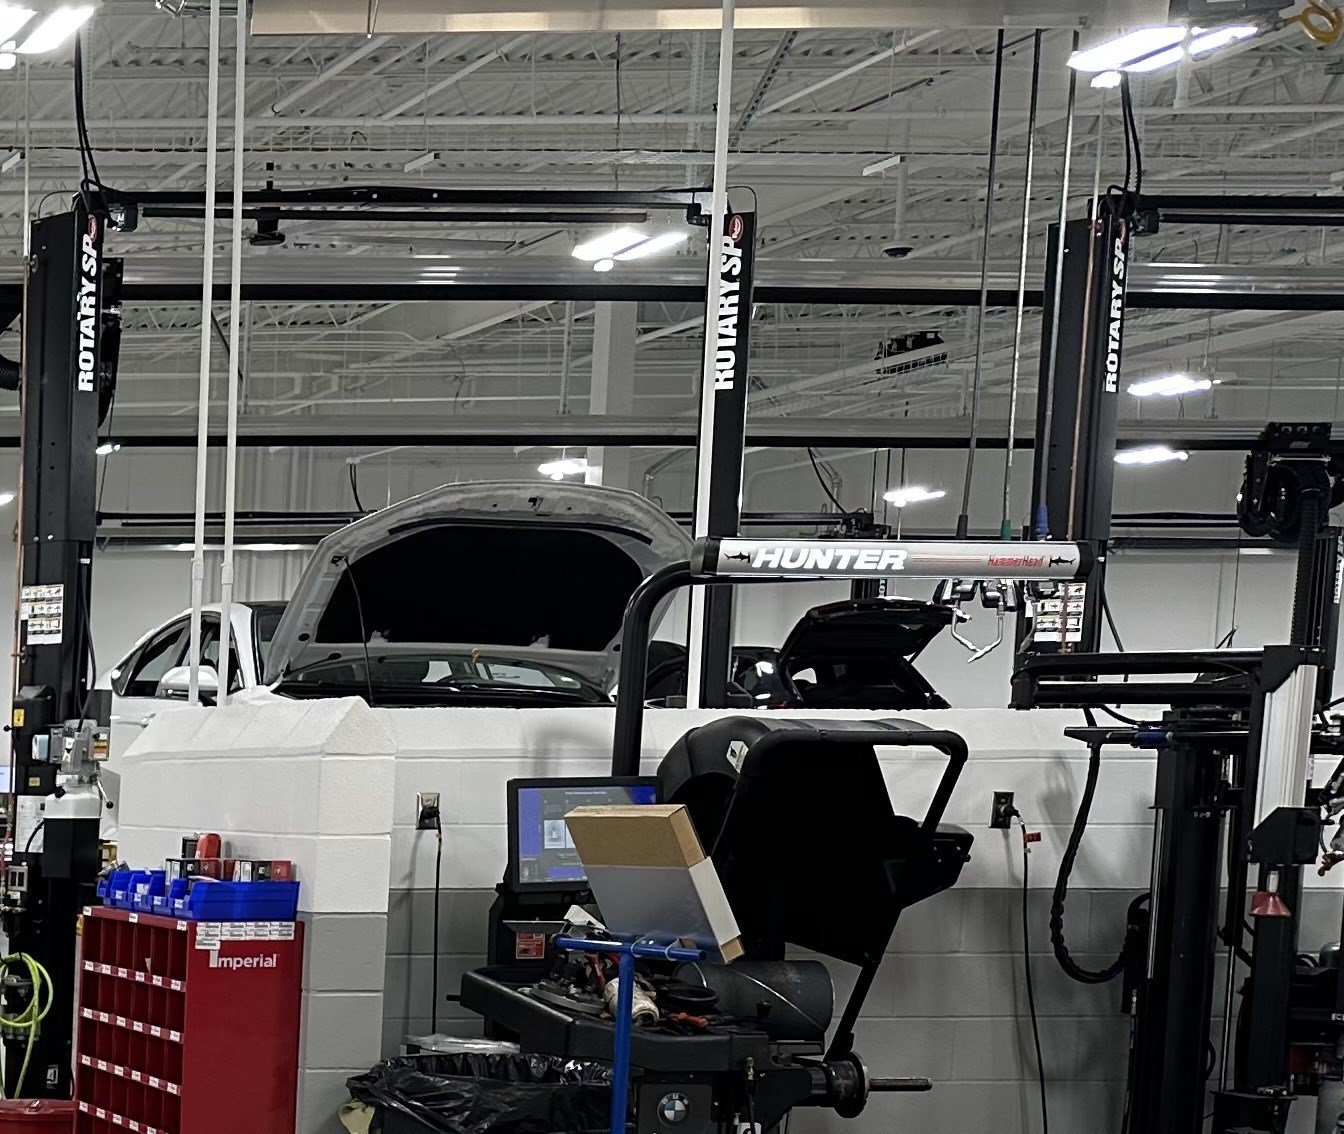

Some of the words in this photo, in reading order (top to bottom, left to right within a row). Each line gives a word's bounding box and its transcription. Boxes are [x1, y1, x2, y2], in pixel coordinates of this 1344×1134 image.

[81, 233, 98, 277] SP
[720, 235, 743, 276] SP
[1113, 237, 1125, 280] SP
[78, 276, 97, 392] ROTARY
[1105, 279, 1123, 393] ROTARY
[751, 547, 909, 570] HUNTER
[209, 949, 278, 971] Imperial
